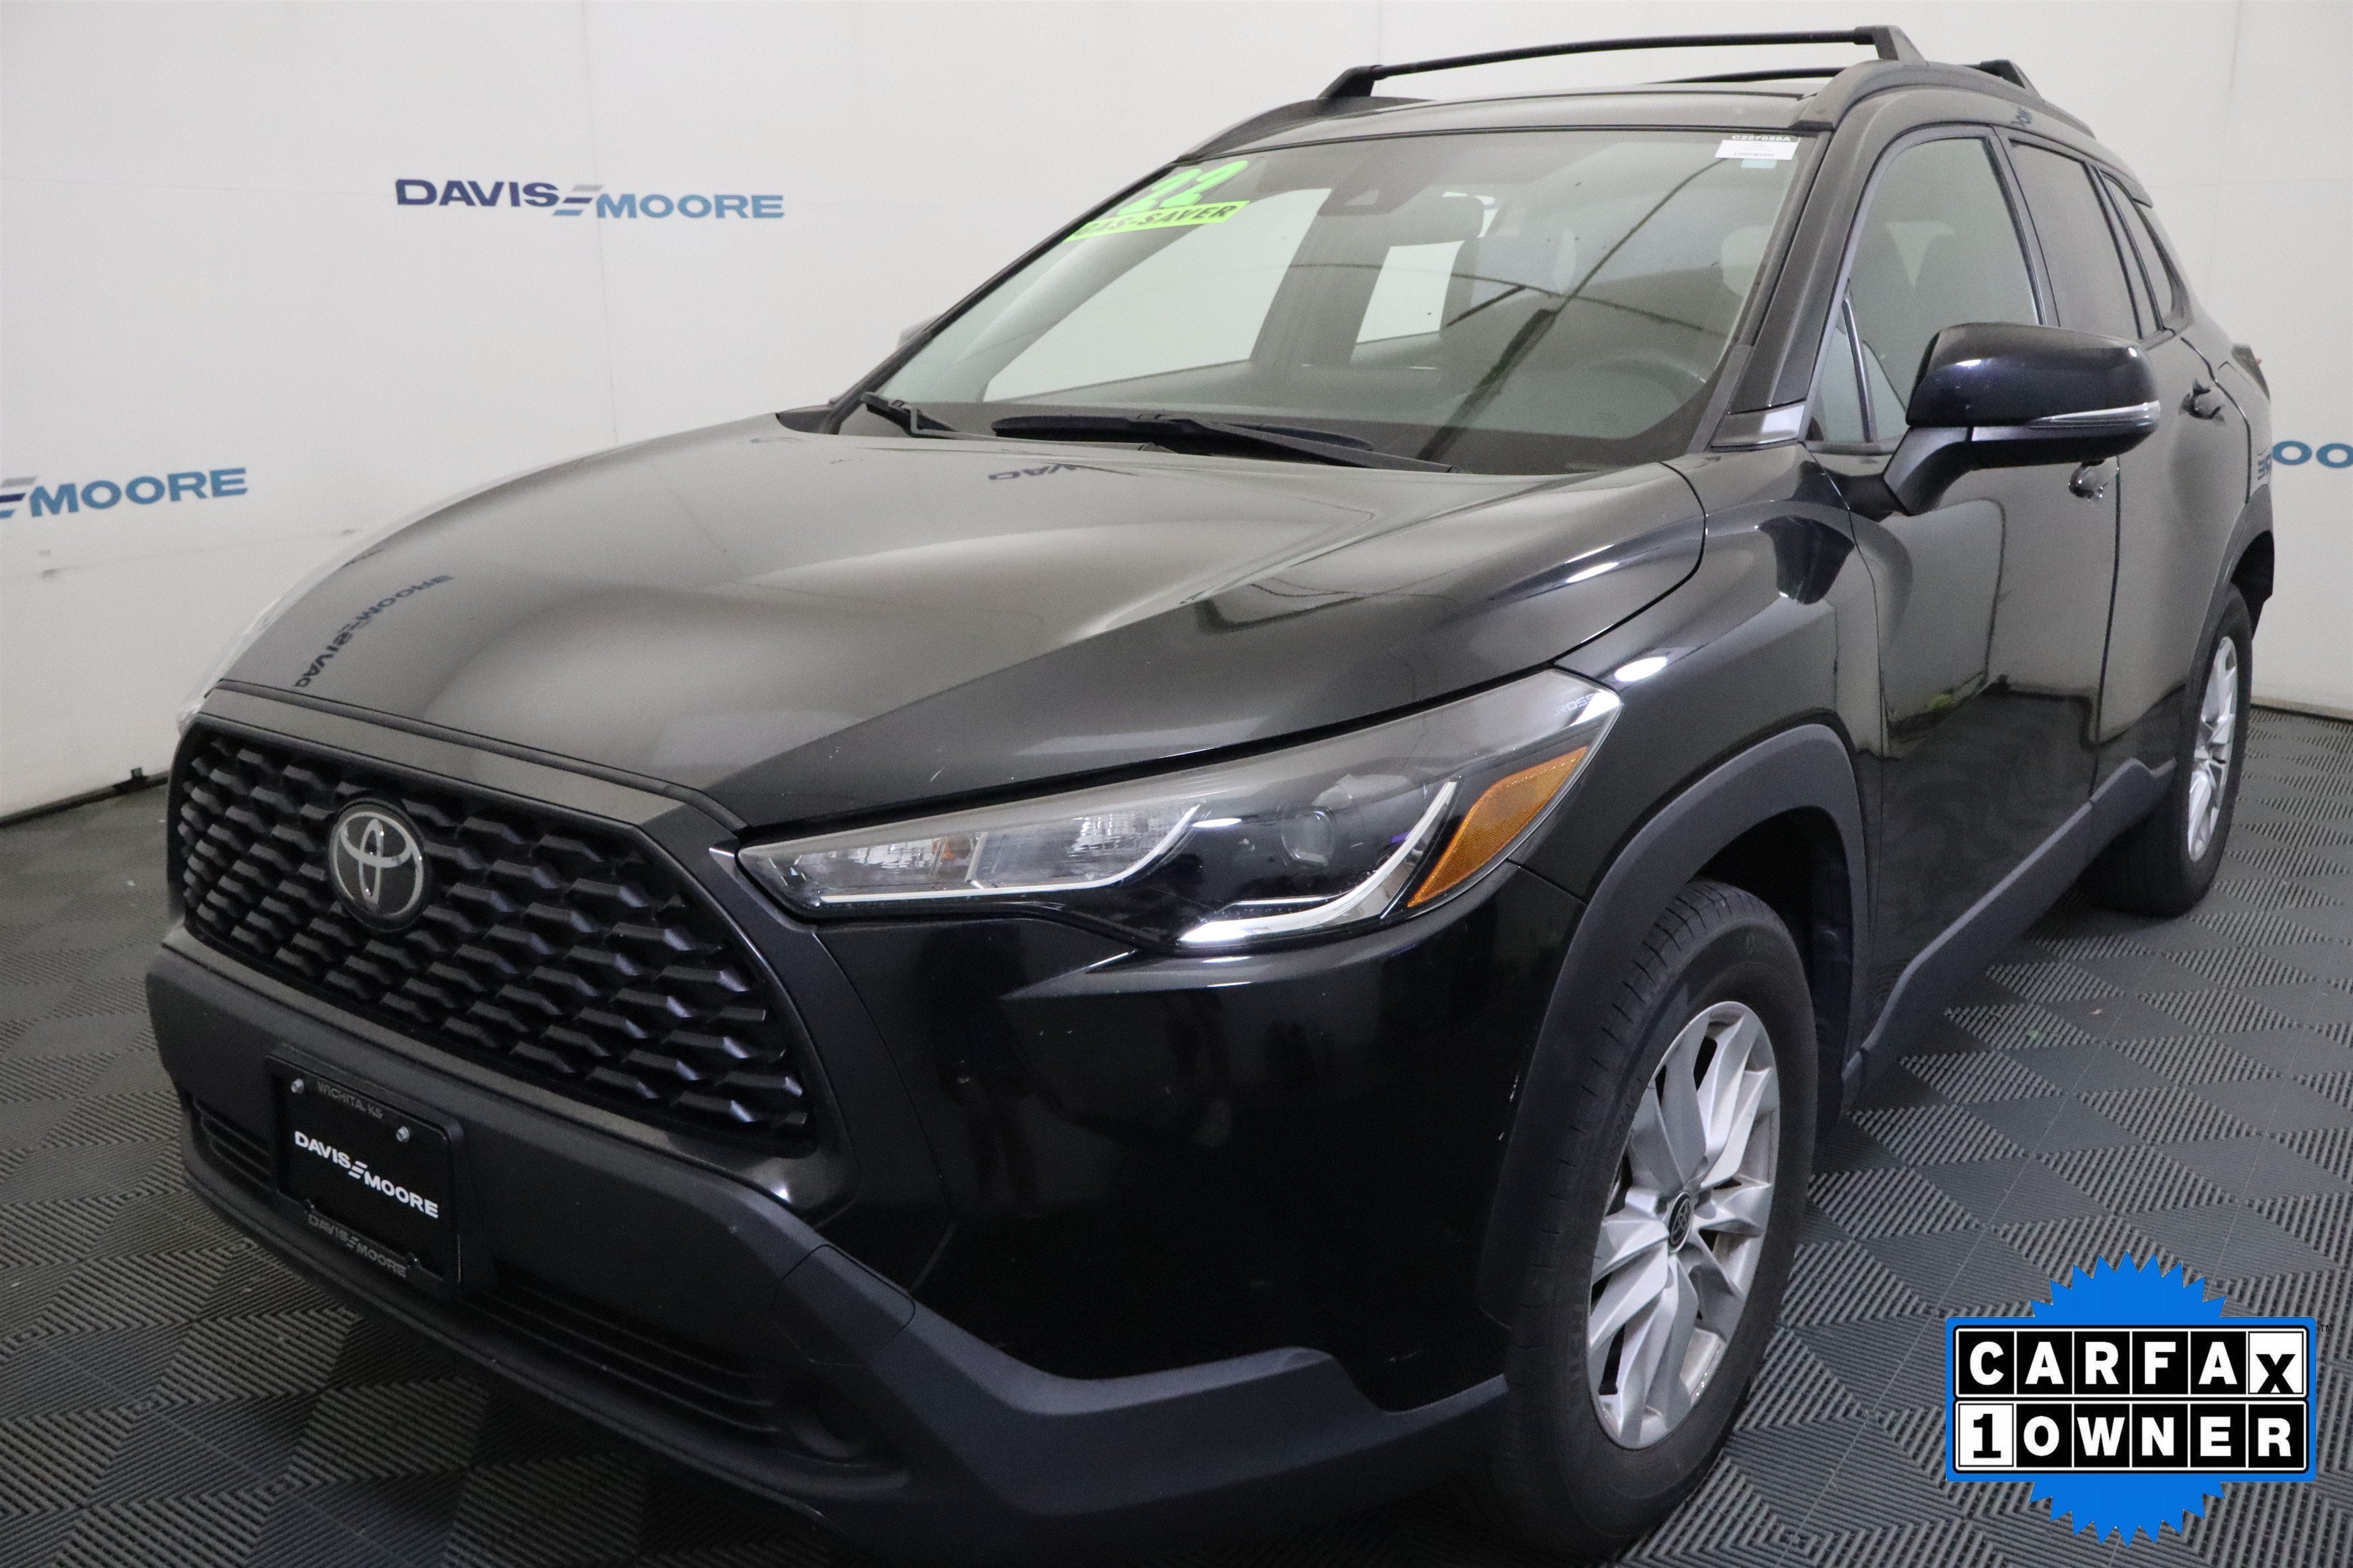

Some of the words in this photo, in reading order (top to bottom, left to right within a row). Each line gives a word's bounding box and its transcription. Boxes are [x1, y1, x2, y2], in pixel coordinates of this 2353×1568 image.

[395, 179, 560, 207] DAVIS
[596, 193, 785, 218] MOORE
[1073, 204, 1239, 236] GAS-SAVER
[29, 468, 248, 517] MOORE
[294, 1130, 352, 1169] DAVIS
[364, 1171, 439, 1219] MOORE
[308, 1213, 349, 1242] DAVIS
[356, 1242, 407, 1278] MOORE
